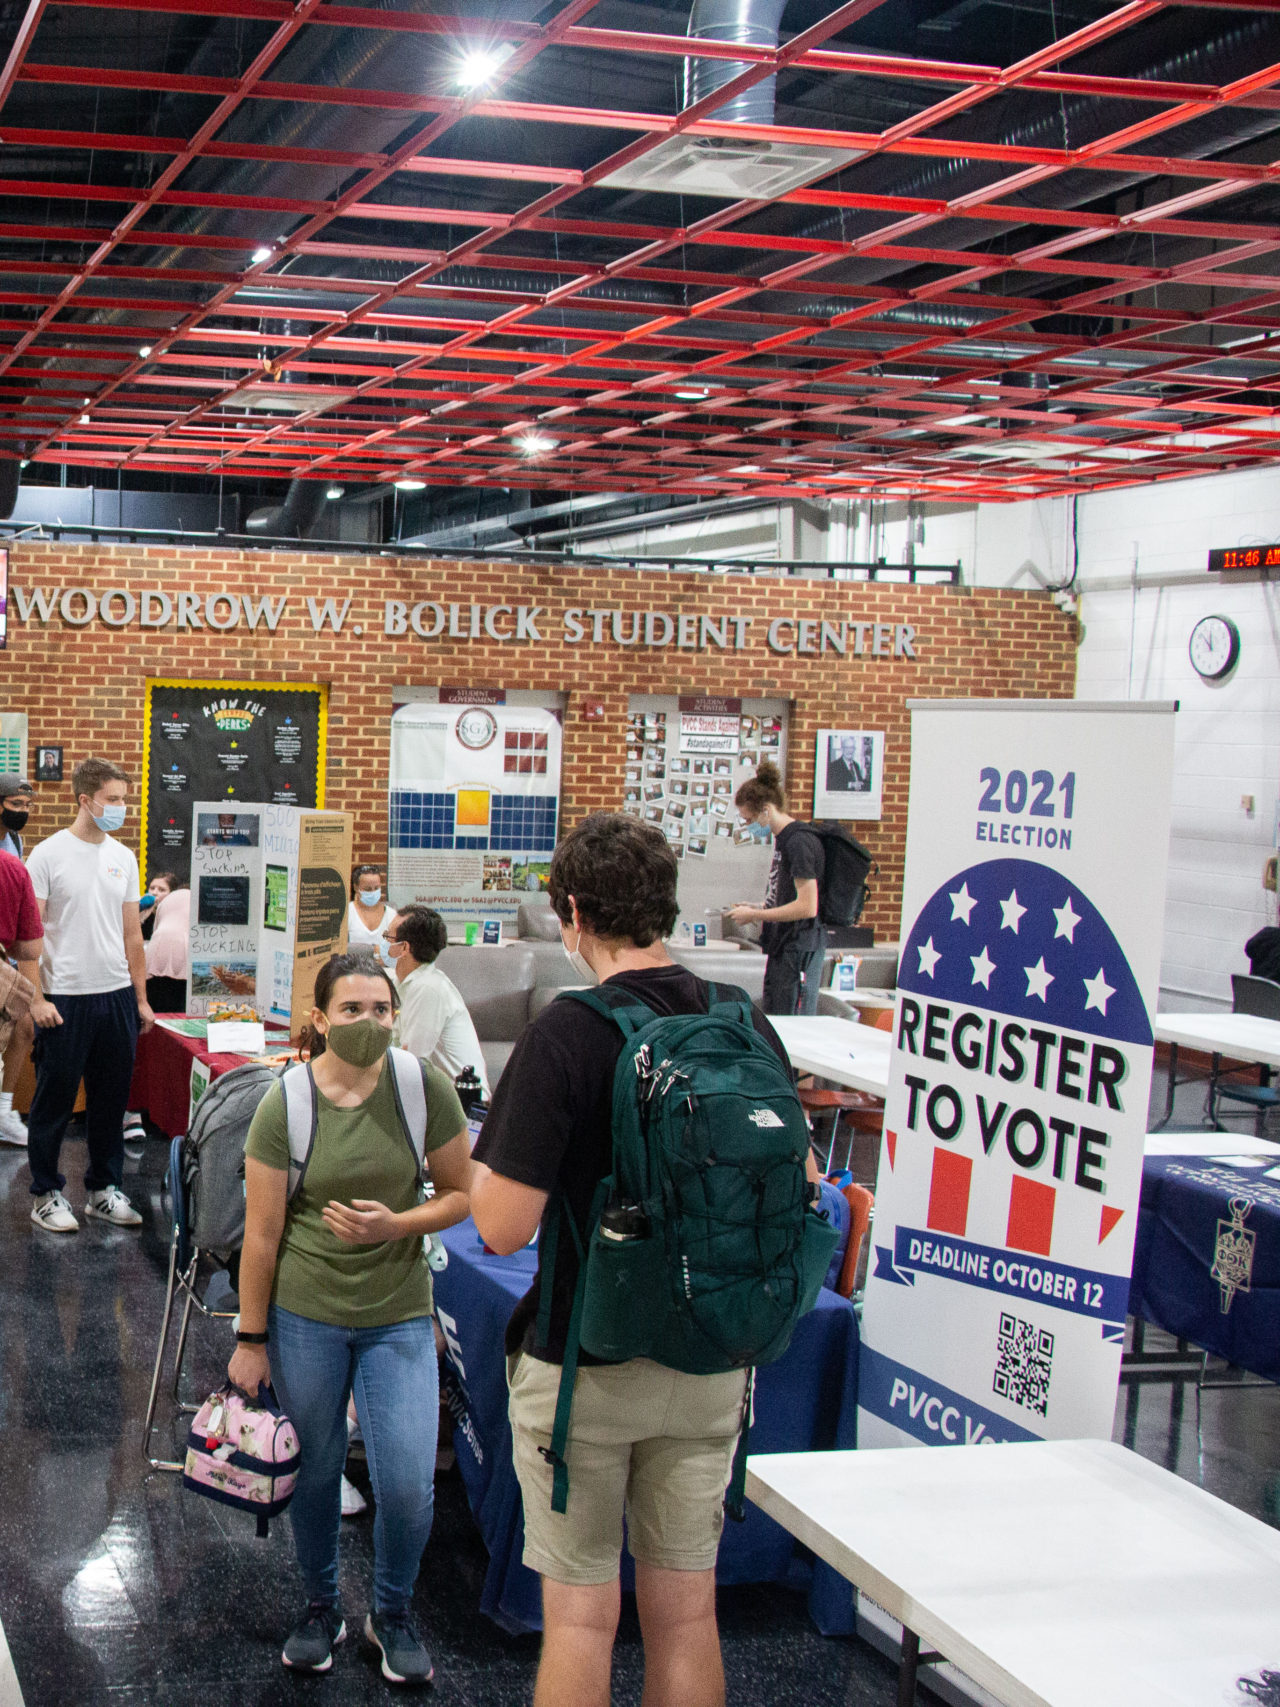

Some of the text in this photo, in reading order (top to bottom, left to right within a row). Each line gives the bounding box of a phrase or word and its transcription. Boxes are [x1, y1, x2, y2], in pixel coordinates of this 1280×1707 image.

[1223, 550, 1260, 568] 11:46
[12, 586, 917, 660] WOODROW W. BOLICK STUDENT CENTER
[203, 698, 267, 718] KNOW THE
[448, 696, 497, 704] GOVERNMENT
[220, 718, 247, 730] PERKS
[462, 721, 492, 737] SGA
[682, 716, 739, 736] PVCC Stands Against
[978, 767, 1076, 820] 2021
[266, 806, 296, 828] 500
[976, 821, 1072, 851] ELECTION
[194, 847, 233, 861] STOP
[191, 926, 229, 939] STOP
[897, 998, 1126, 1110] REGISTER
[904, 1074, 965, 1141] TO
[976, 1094, 1109, 1194] VOTE
[681, 1254, 694, 1300] BOREALIS
[909, 1239, 1105, 1309] DEADLINE OCTOBER 12
[889, 1378, 961, 1441] PVCC
